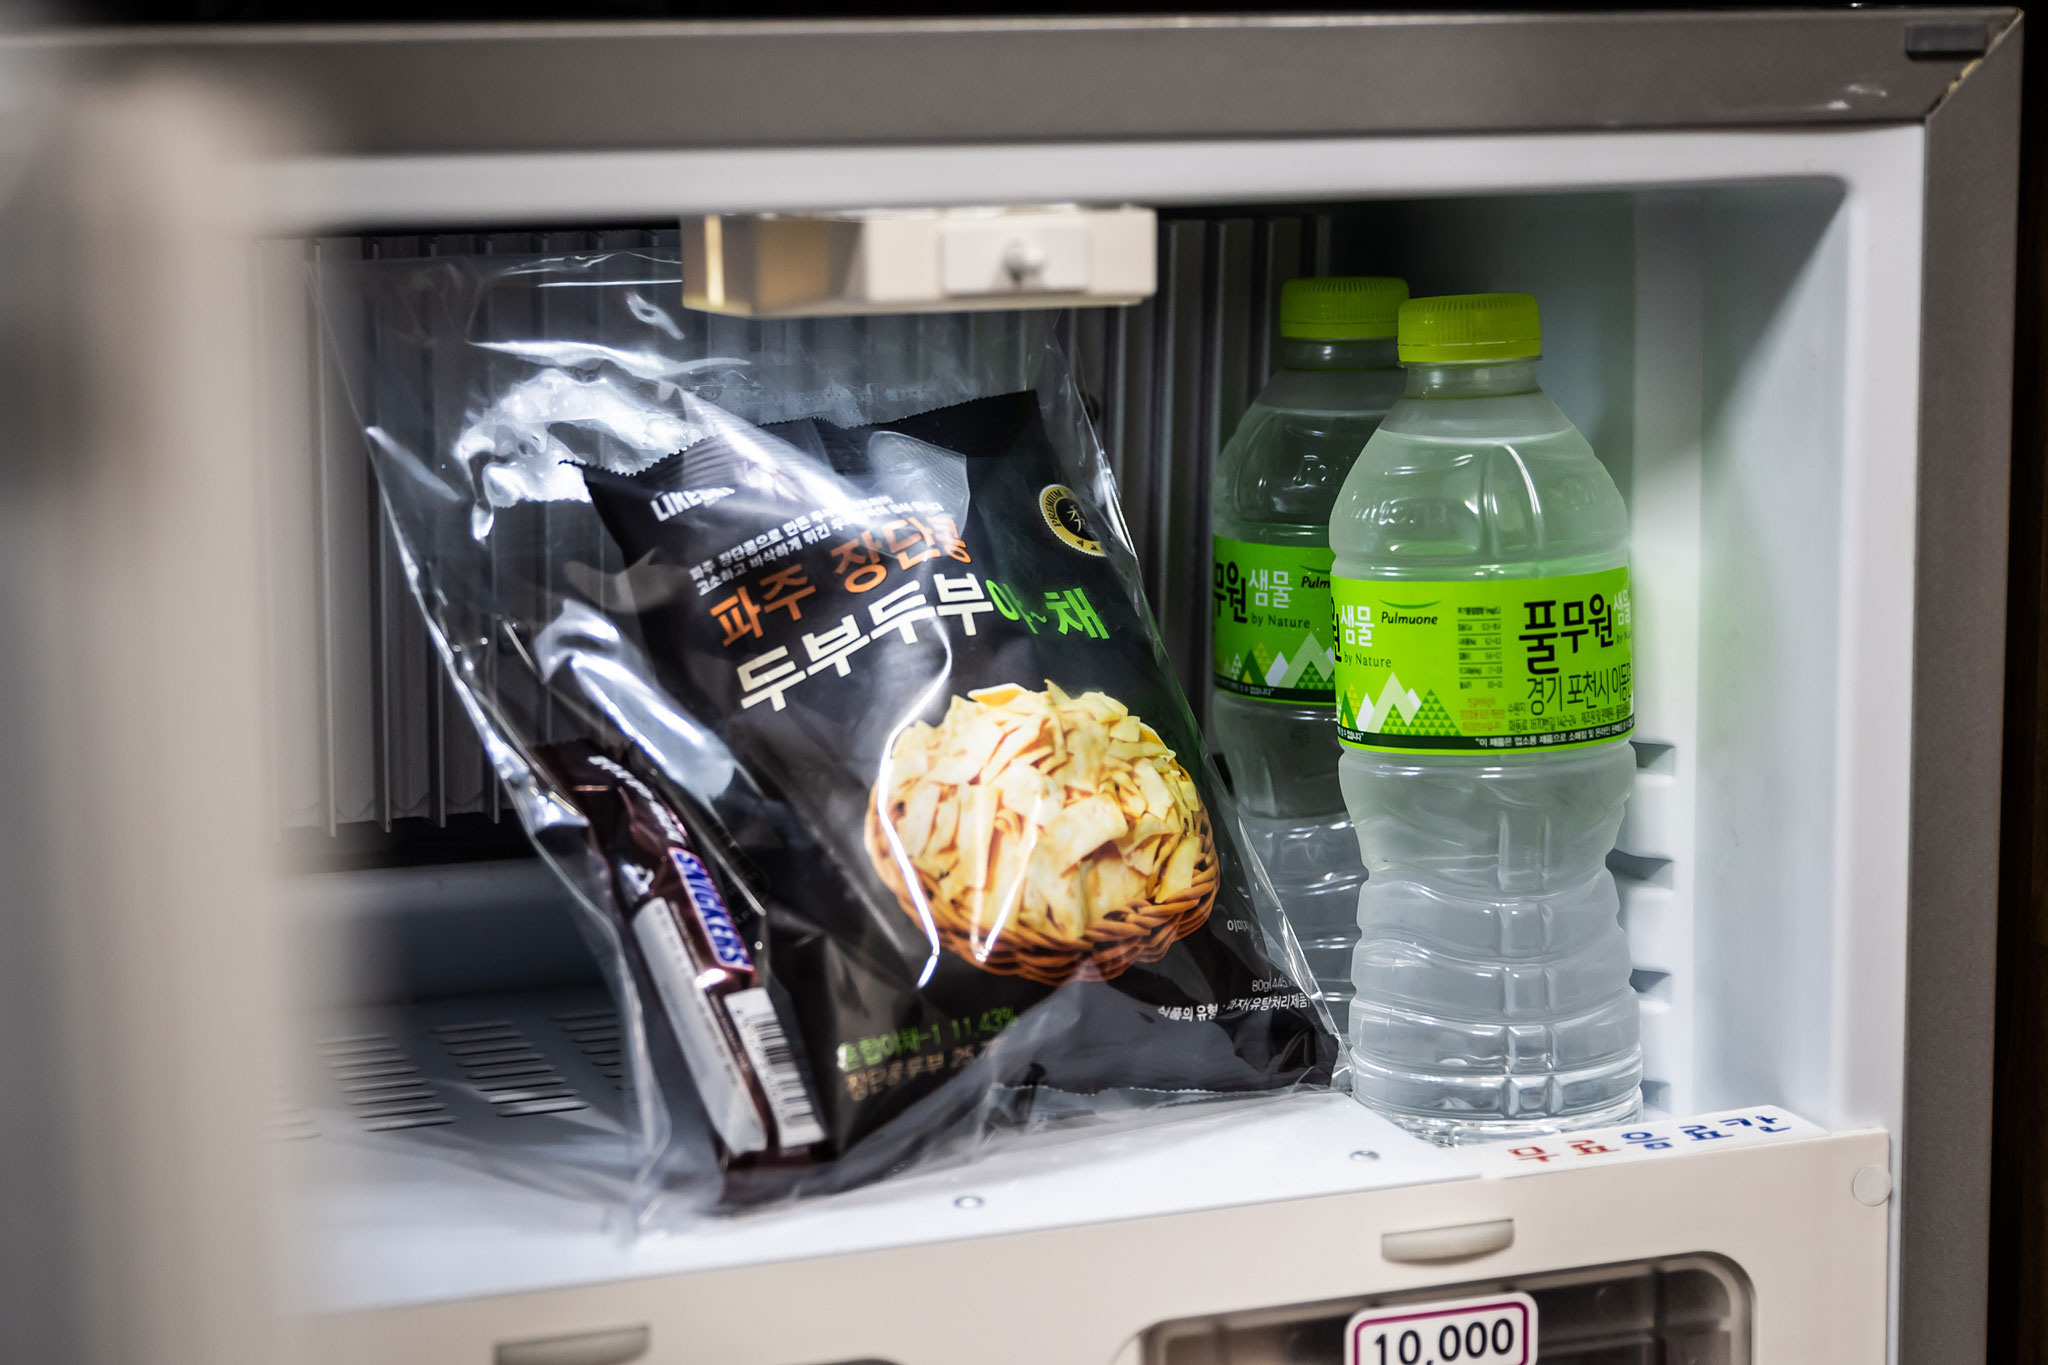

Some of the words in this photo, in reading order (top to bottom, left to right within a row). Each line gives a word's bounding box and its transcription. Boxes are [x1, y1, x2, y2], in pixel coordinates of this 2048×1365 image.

[1045, 489, 1063, 527] PREMIUM
[710, 563, 816, 647] 파주
[830, 514, 972, 594] 장단콩
[1249, 569, 1293, 609] 샘물
[1251, 613, 1264, 627] by
[1268, 613, 1311, 629] Nature
[1341, 604, 1375, 647] 샘물
[1381, 610, 1438, 625] Pulmuone
[1518, 593, 1614, 676] 풀무원
[737, 572, 995, 713] 두부두부
[1344, 651, 1352, 665] by
[1355, 653, 1392, 668] Nature
[1526, 675, 1563, 716] 경기
[1566, 667, 1610, 709] 포천시
[676, 852, 749, 966] SNICKERS
[1157, 1005, 1194, 1022] 식품의
[1196, 1003, 1219, 1022] 유형
[1375, 1318, 1514, 1365] 10,000
